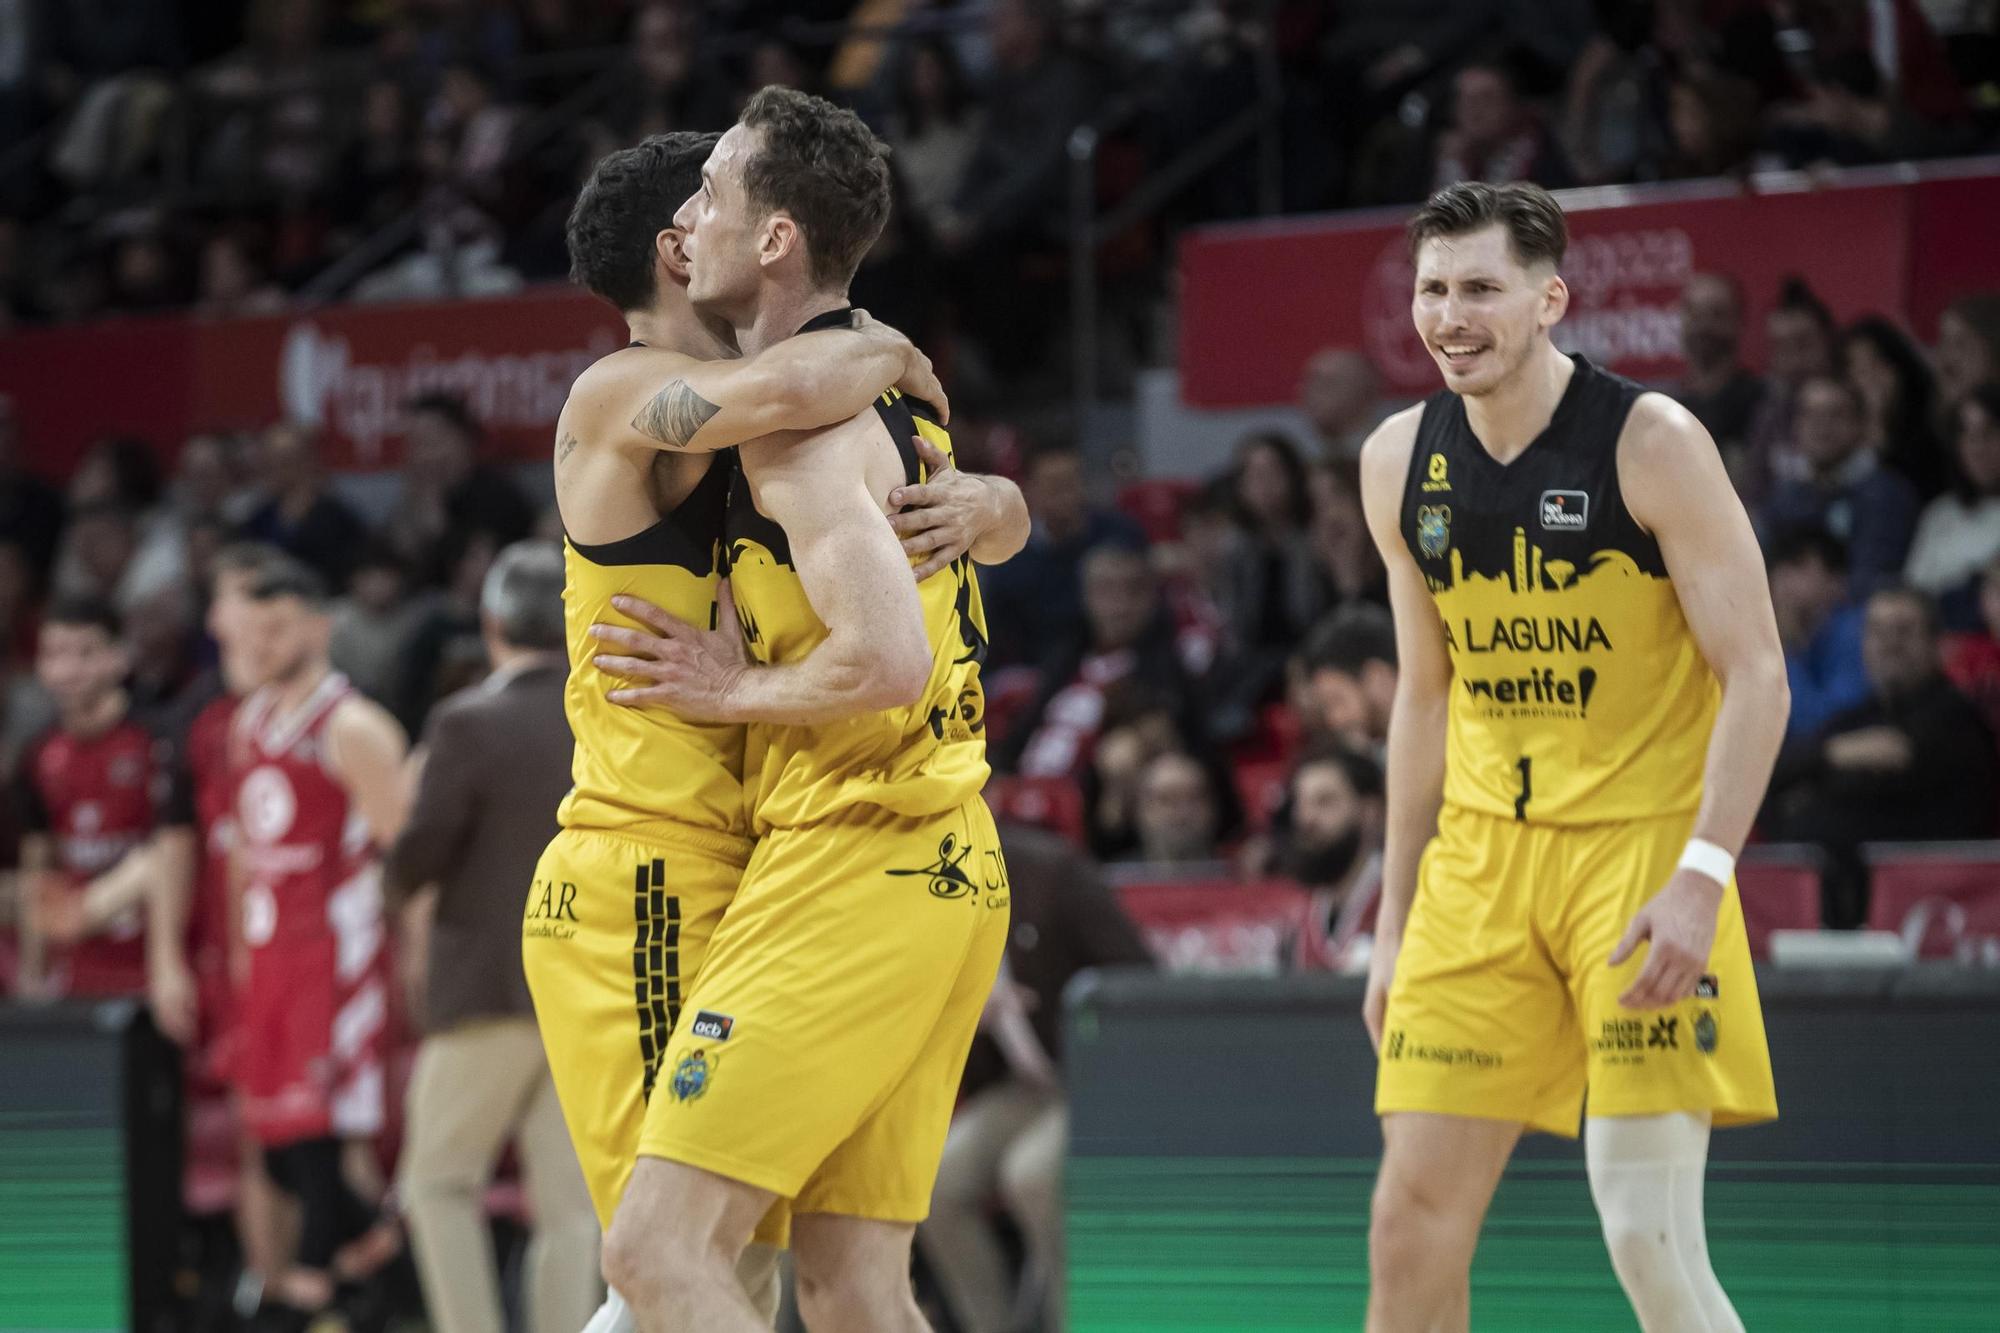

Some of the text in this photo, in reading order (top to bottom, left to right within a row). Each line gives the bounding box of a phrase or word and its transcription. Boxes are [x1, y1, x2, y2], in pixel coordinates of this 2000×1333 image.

[1464, 616, 1613, 652] LAGUNA
[1515, 756, 1532, 822] 1
[695, 1020, 722, 1038] acb
